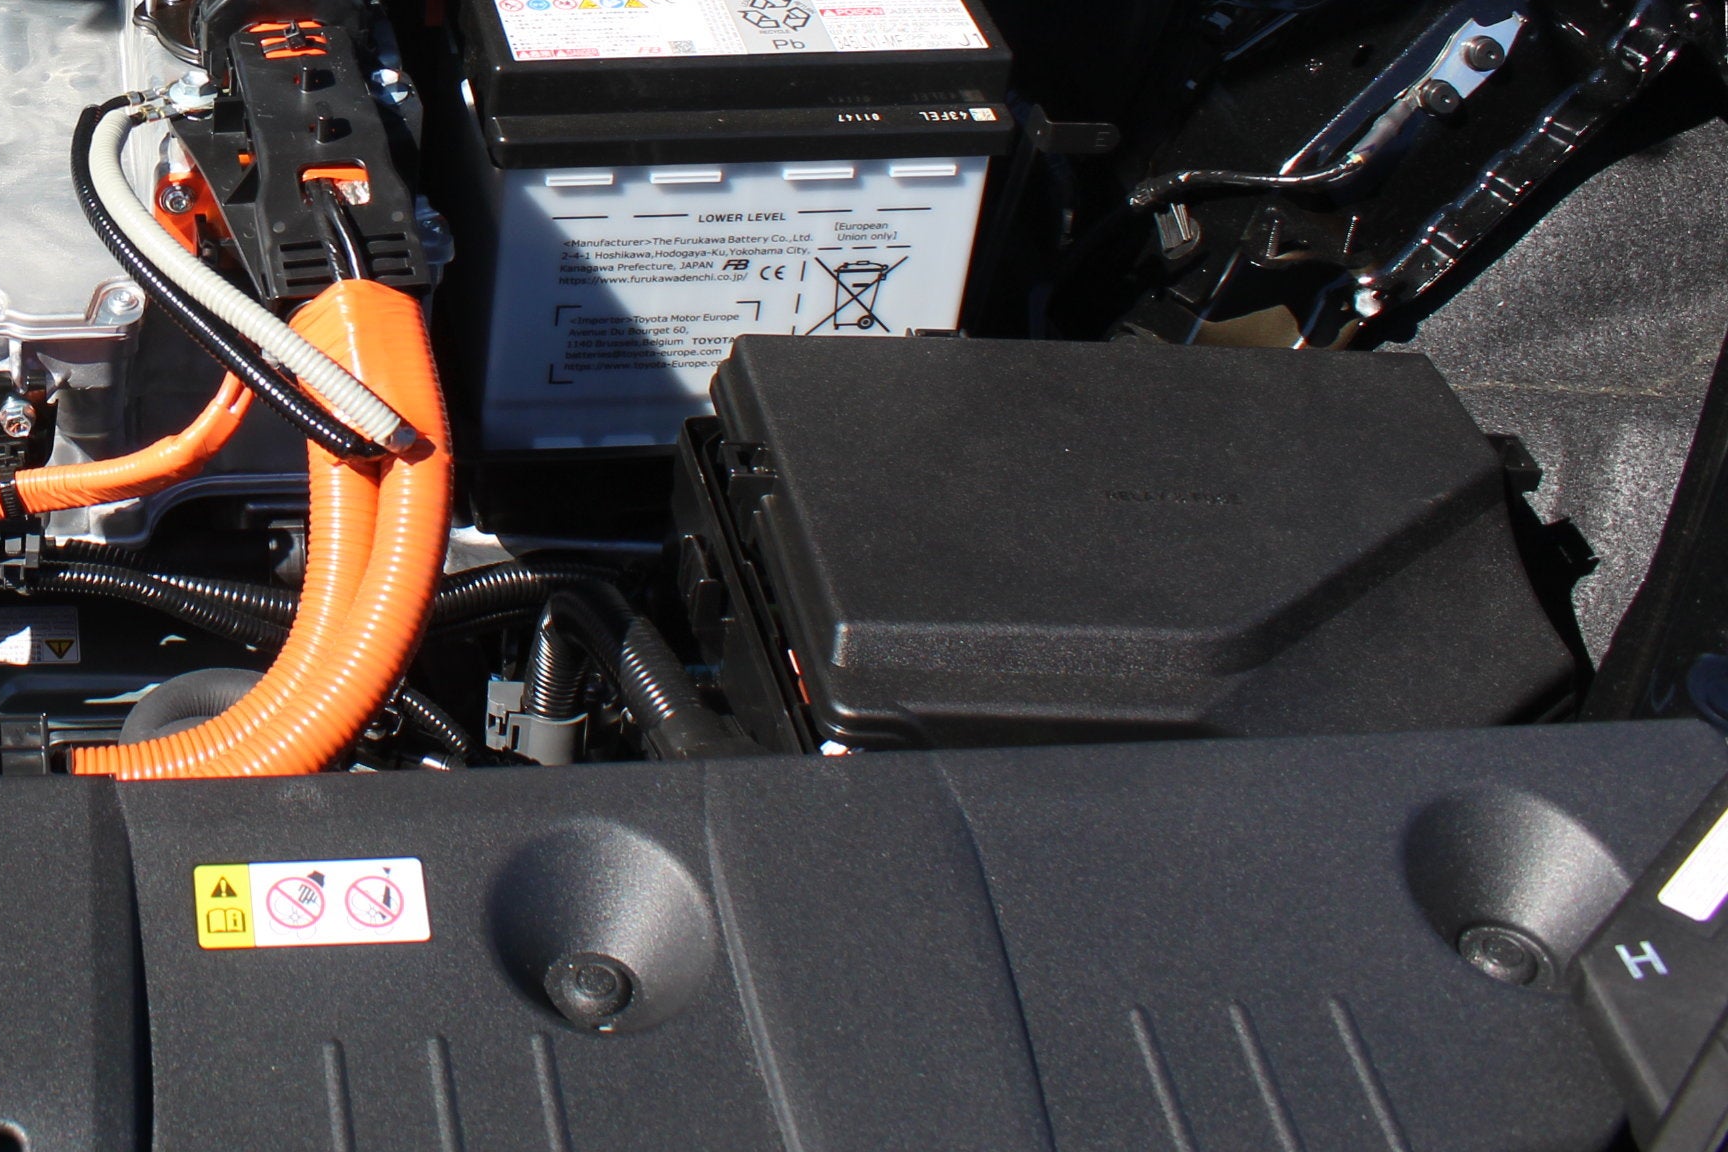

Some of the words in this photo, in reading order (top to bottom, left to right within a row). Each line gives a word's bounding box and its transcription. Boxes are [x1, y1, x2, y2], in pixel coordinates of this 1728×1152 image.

[772, 38, 806, 50] Pb
[698, 213, 743, 223] LOWER
[747, 212, 786, 222] LEVEL
[834, 221, 889, 232] [European
[674, 235, 726, 245] Furukawa
[727, 235, 769, 245] Battery
[837, 232, 867, 241] Union
[870, 230, 898, 241] only]
[561, 251, 590, 261] 2-4-1
[559, 263, 614, 274] Kanagawa
[617, 261, 677, 272] Prefecture,
[679, 260, 714, 270] JAPAN
[759, 264, 786, 281] CE
[670, 314, 701, 323] Motor
[703, 313, 740, 323] Europe
[568, 328, 607, 337] Avenue
[610, 328, 625, 336] Du
[628, 326, 670, 337] Bourget
[672, 325, 690, 335] 60,
[567, 340, 592, 348] 1140
[692, 336, 736, 345] TOYOTA
[564, 347, 722, 359] batteries@toyota-europe.com
[1614, 940, 1669, 979] H
